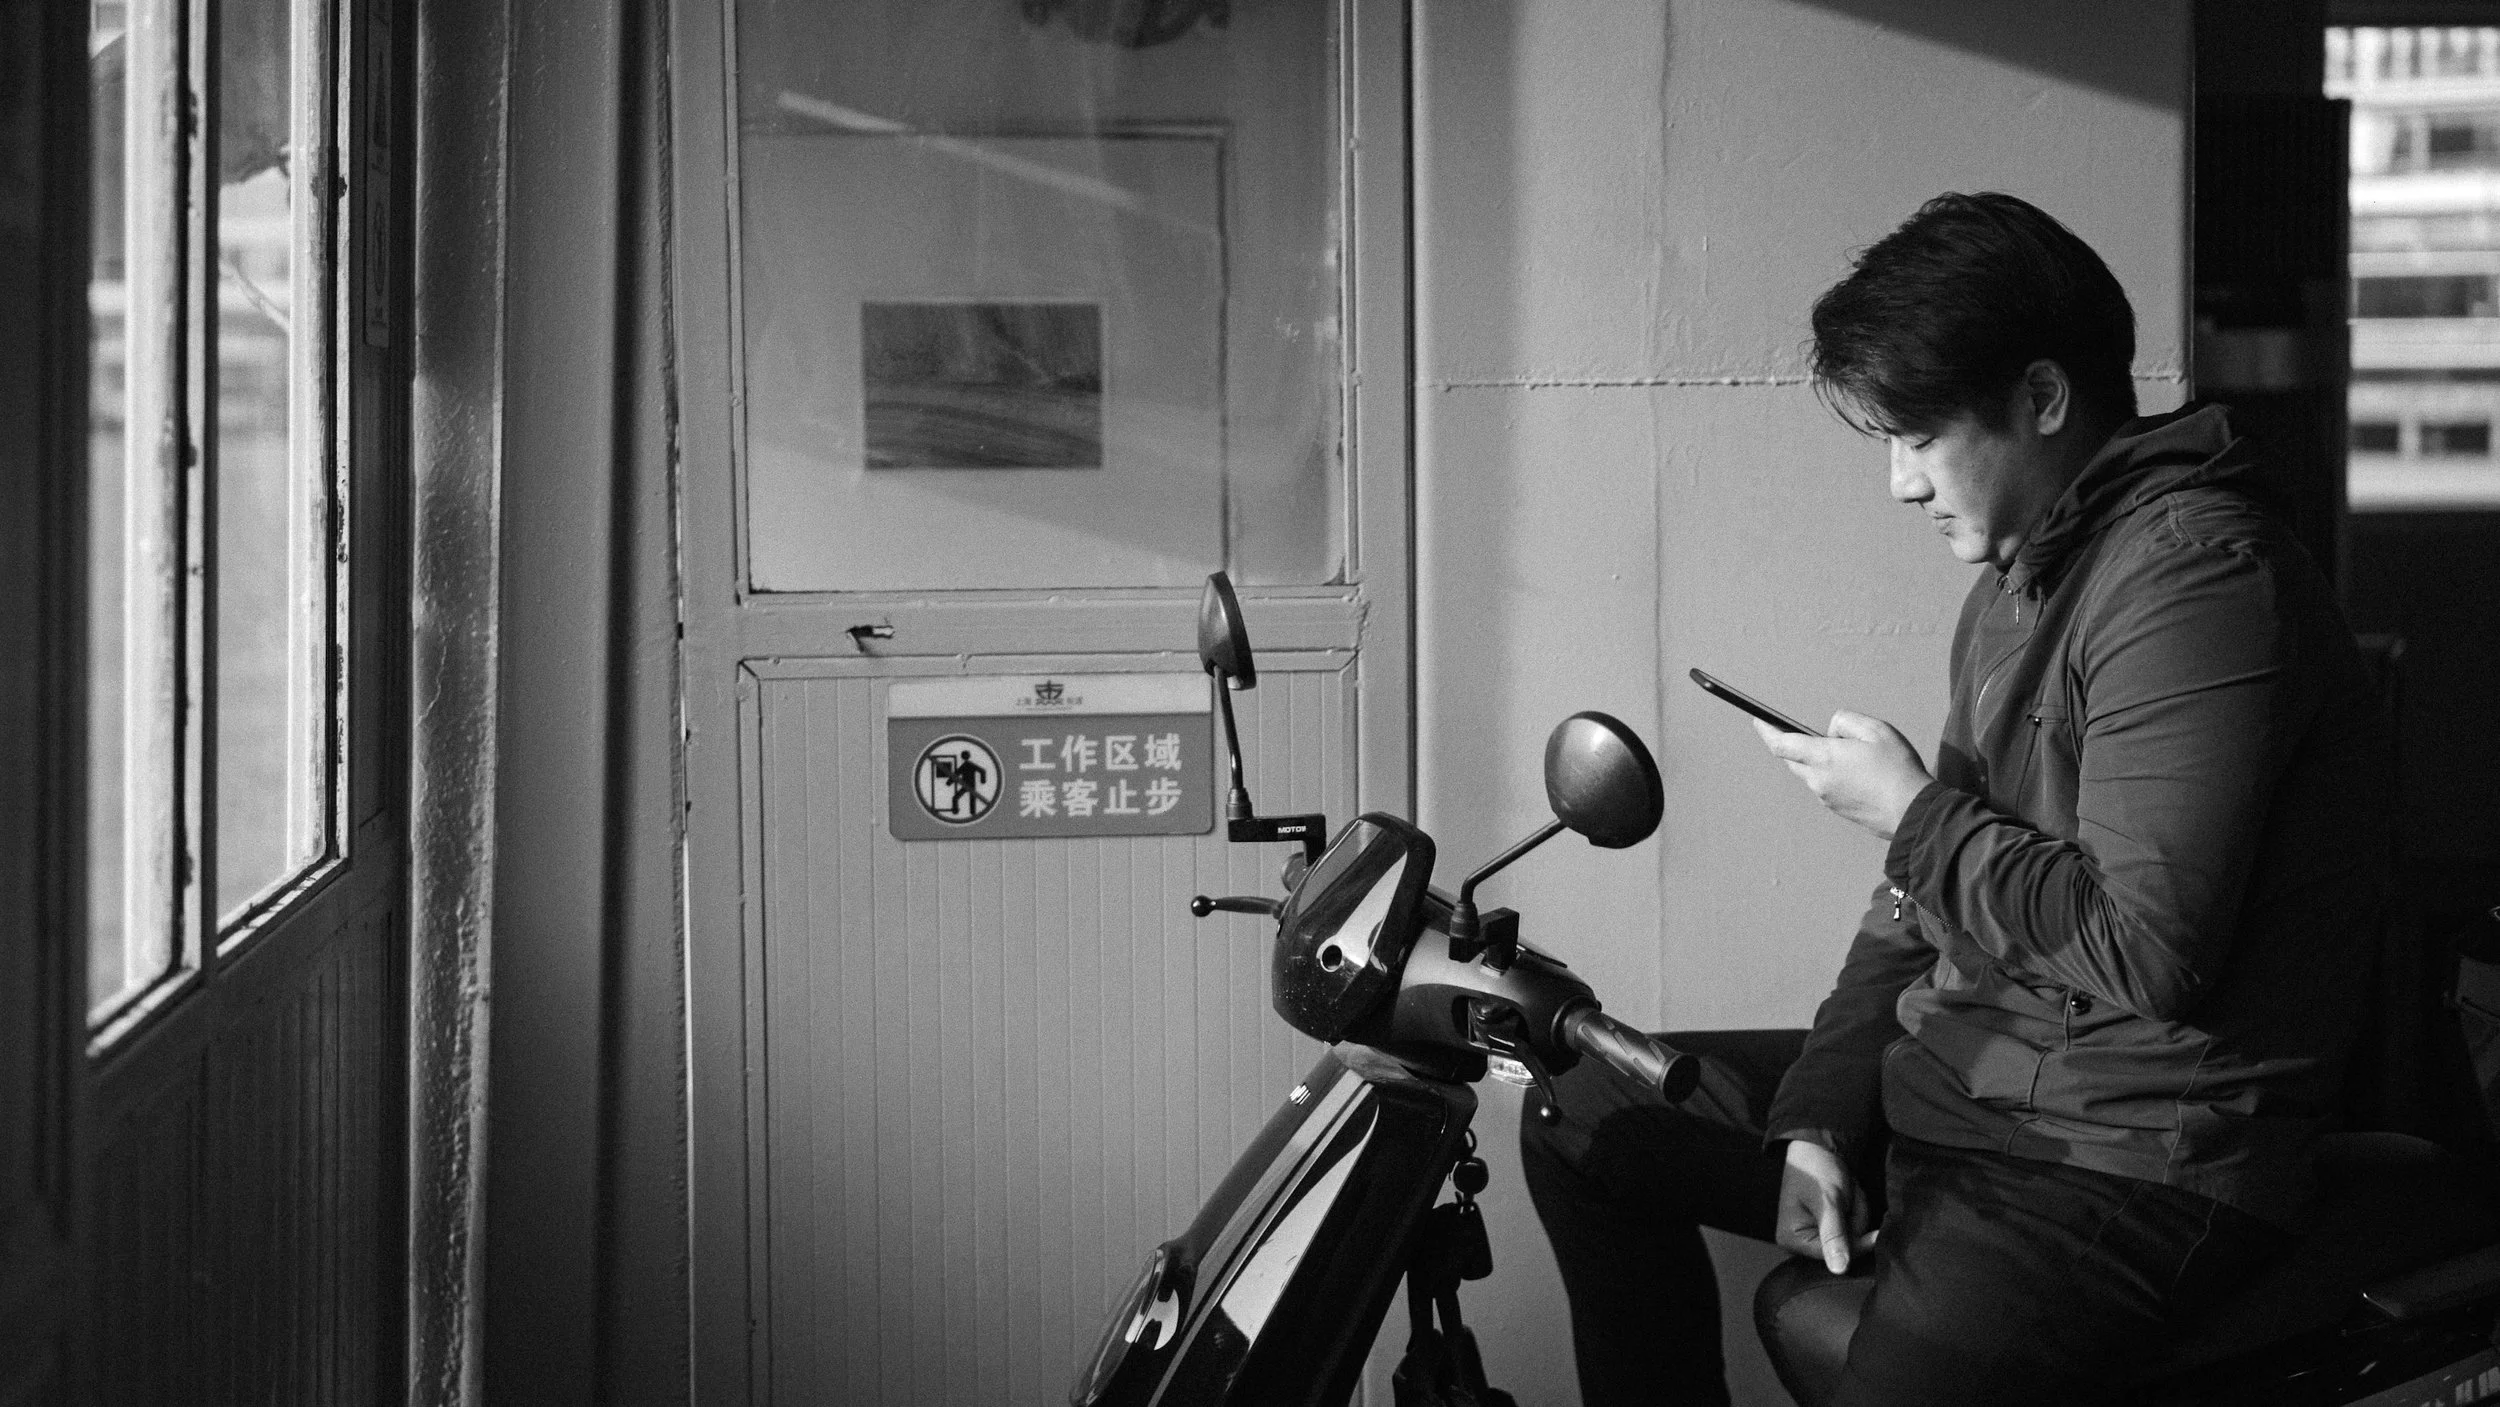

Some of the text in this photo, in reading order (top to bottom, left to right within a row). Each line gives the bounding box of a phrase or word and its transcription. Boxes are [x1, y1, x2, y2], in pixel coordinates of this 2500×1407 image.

[1018, 732, 1183, 773] 工作区域
[1018, 776, 1183, 818] 乘客止步
